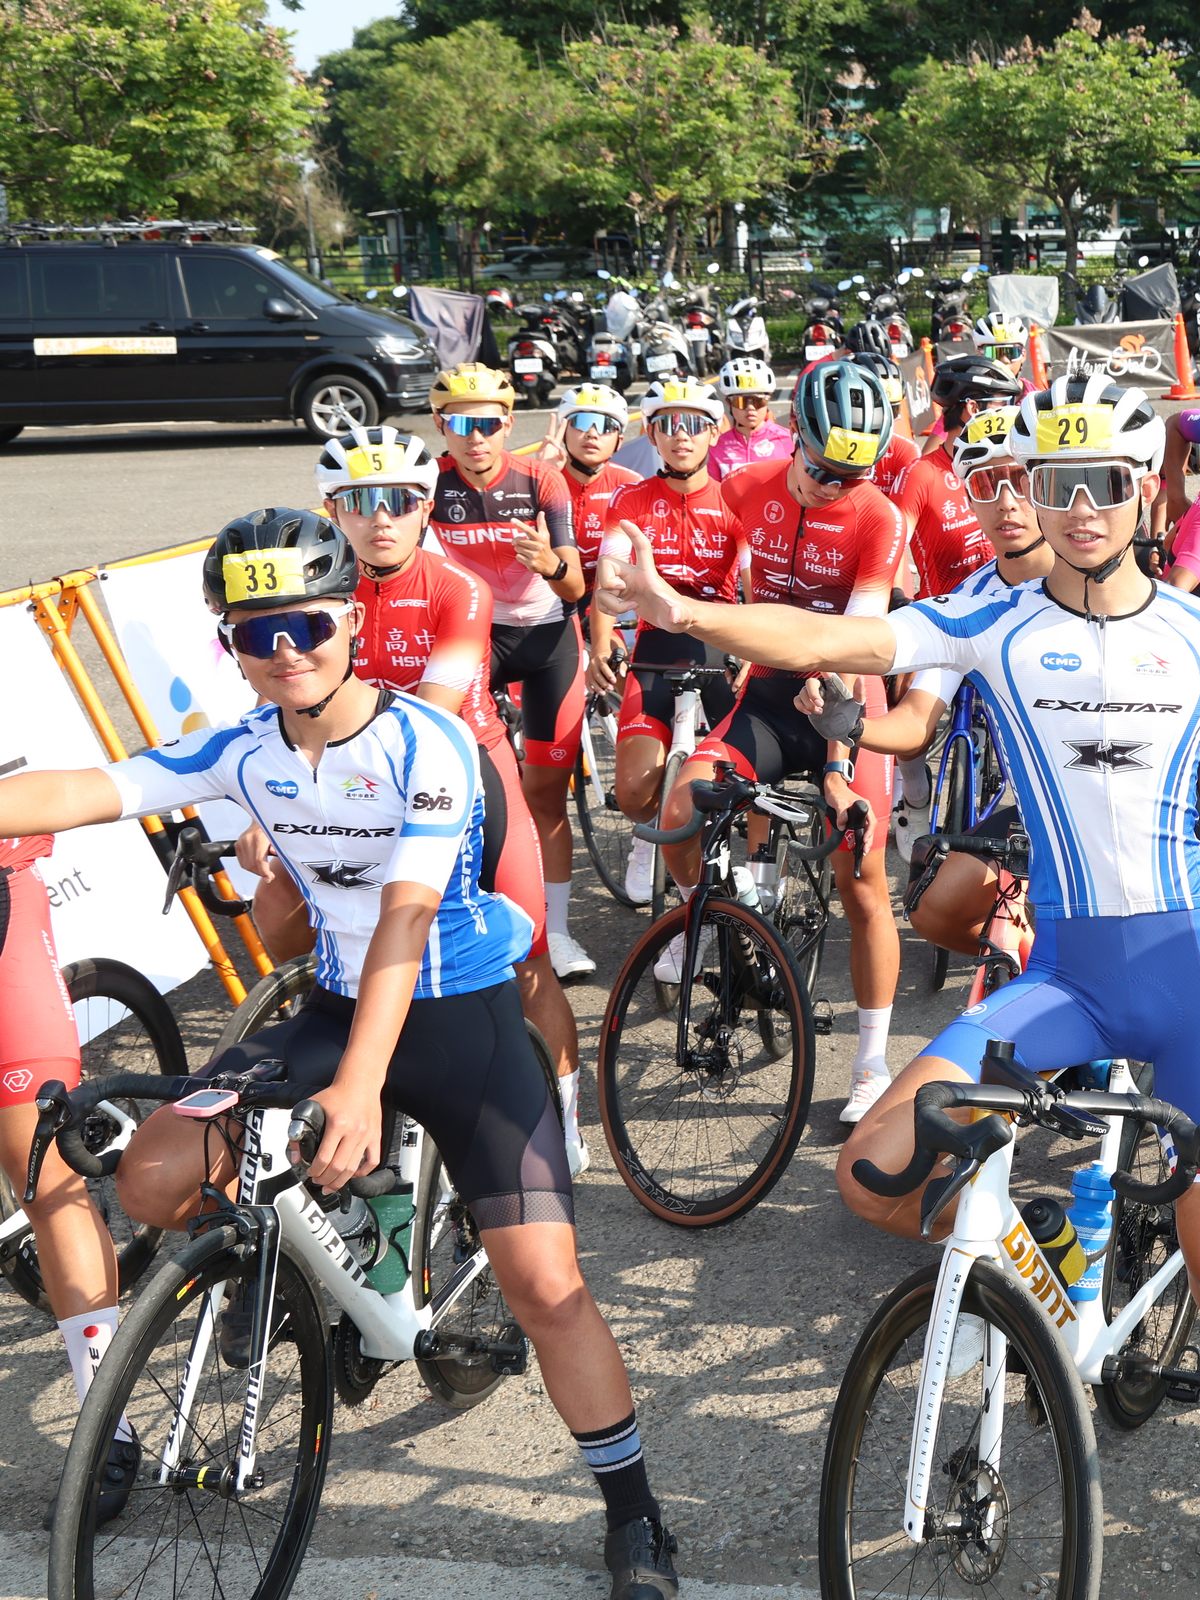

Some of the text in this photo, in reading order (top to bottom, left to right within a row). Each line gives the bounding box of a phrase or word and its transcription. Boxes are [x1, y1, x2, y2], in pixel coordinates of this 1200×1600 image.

[468, 377, 476, 391] 8
[984, 416, 1005, 434] 32
[1058, 417, 1088, 446] 29
[847, 442, 857, 461] 2
[373, 453, 382, 471] 5
[444, 490, 467, 498] ZIV
[806, 520, 845, 533] VERGE
[803, 541, 844, 566] 高中
[886, 540, 900, 565] TIRE
[244, 562, 278, 593] 33
[804, 561, 841, 577] HSHS
[388, 598, 430, 609] VERGE
[467, 590, 480, 621] TIRE
[385, 628, 437, 653] 高中
[391, 656, 428, 667] HSH
[1043, 656, 1081, 667] KMC
[1033, 699, 1183, 715] EXUSTAR
[267, 783, 297, 795] KMC
[273, 823, 396, 838] EXUSTAR
[50, 867, 91, 908] ent
[461, 832, 489, 936] XUSTAR
[1086, 1124, 1107, 1135] bryton
[29, 1138, 41, 1184] ULTEGRA
[240, 1109, 265, 1205] GIANT
[1001, 1220, 1077, 1329] GIANT
[915, 1286, 958, 1499] KRISTIAN BLUMMENFELT
